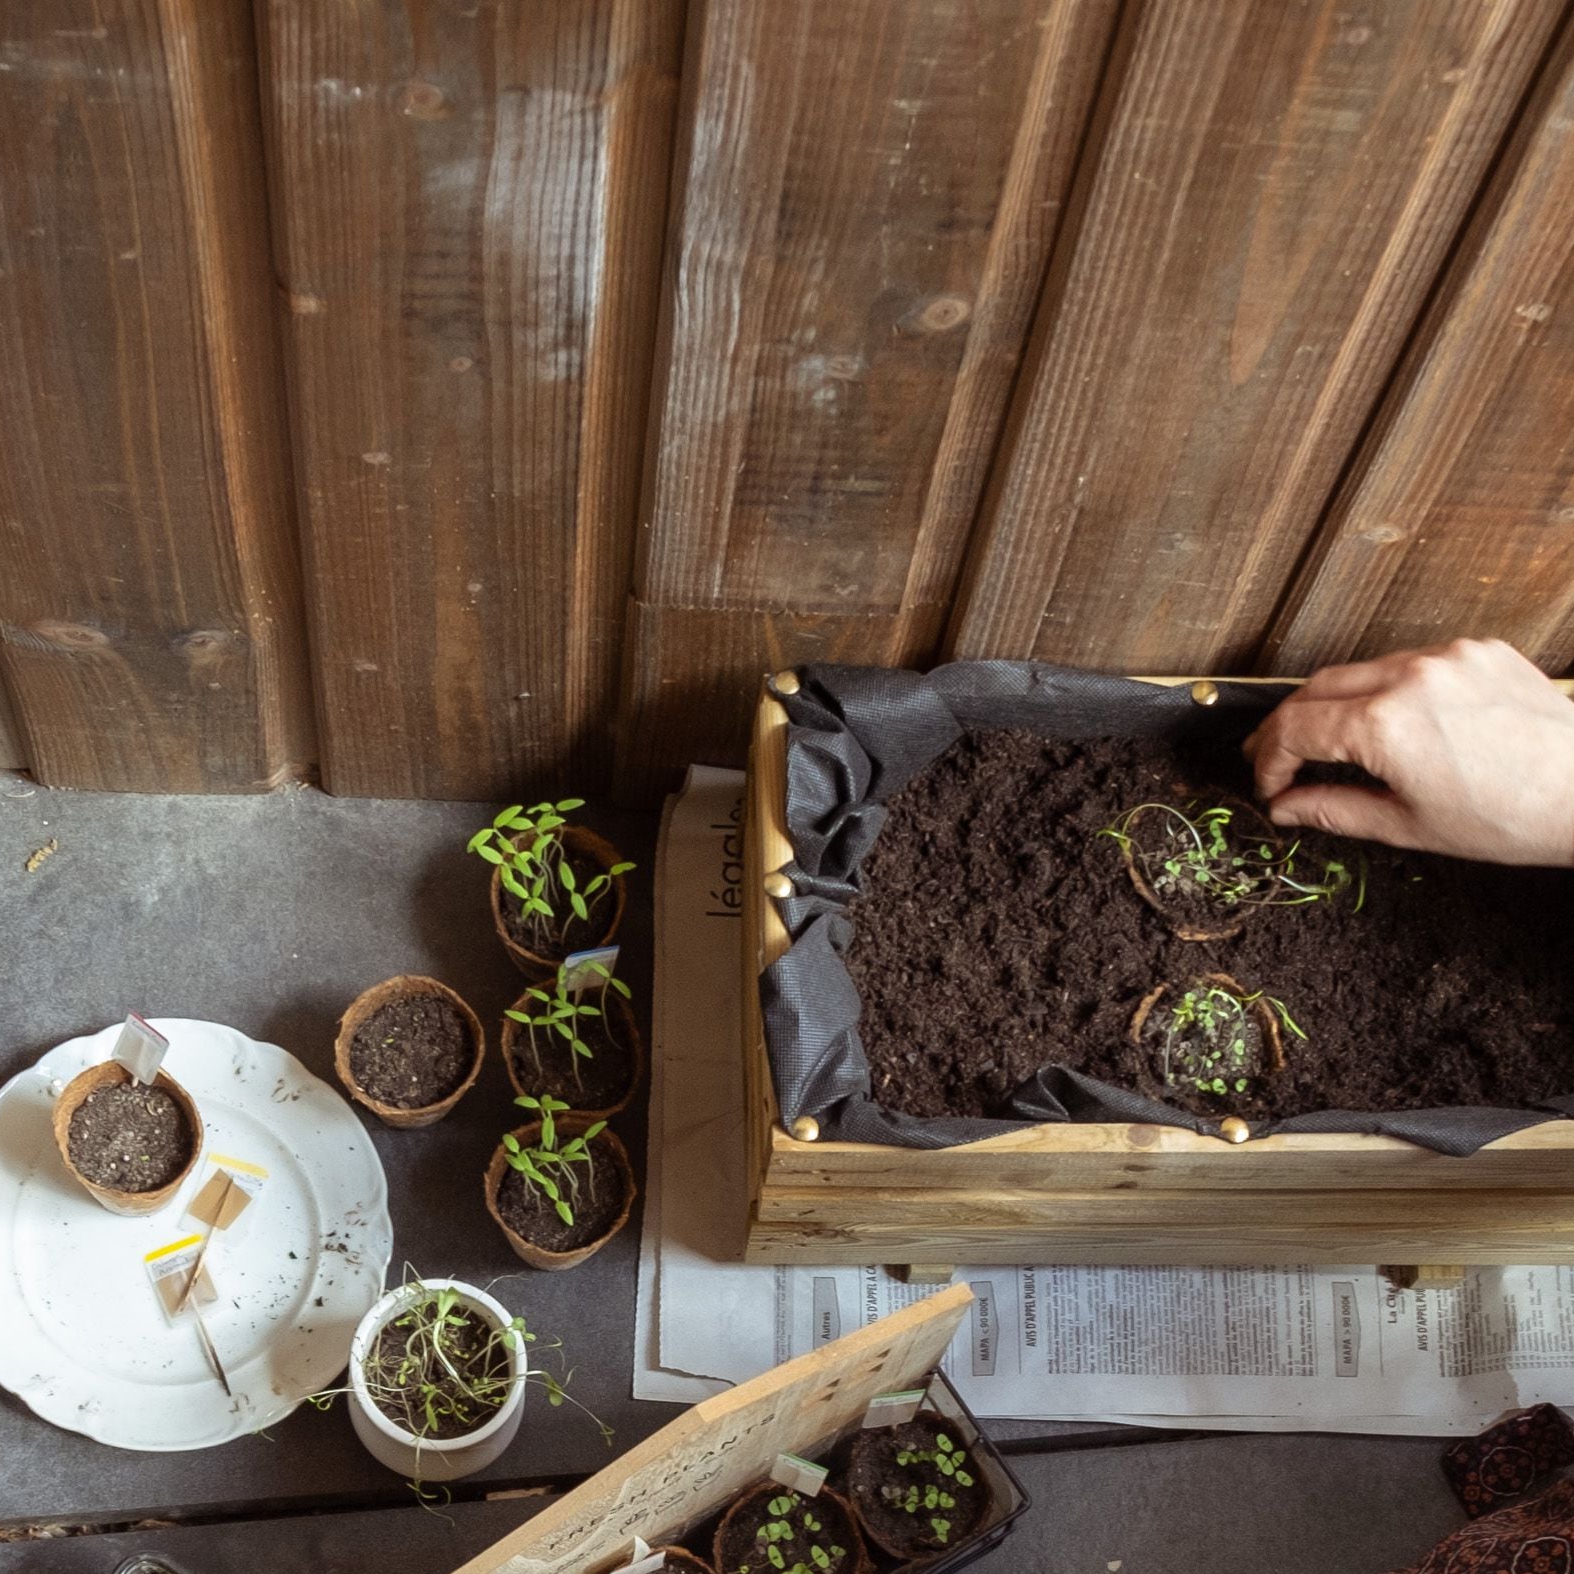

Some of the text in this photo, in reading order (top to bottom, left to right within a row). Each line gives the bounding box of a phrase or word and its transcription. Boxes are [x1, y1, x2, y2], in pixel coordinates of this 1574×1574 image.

[865, 1284, 878, 1312] D'APPEL
[1024, 1275, 1035, 1299] PUBLIC
[821, 1311, 831, 1340] Autres
[866, 1313, 879, 1325] VIS
[979, 1318, 989, 1329] 90
[1025, 1300, 1036, 1329] D'APPEL
[1387, 1311, 1397, 1324] La
[1415, 1288, 1428, 1351] AVIS D'APPEL PUB
[980, 1338, 991, 1361] MAPA
[1025, 1330, 1036, 1347] AVIS
[1343, 1339, 1352, 1364] MAPA
[548, 1489, 647, 1550] FRESH
[662, 1413, 775, 1484] PLANTS
